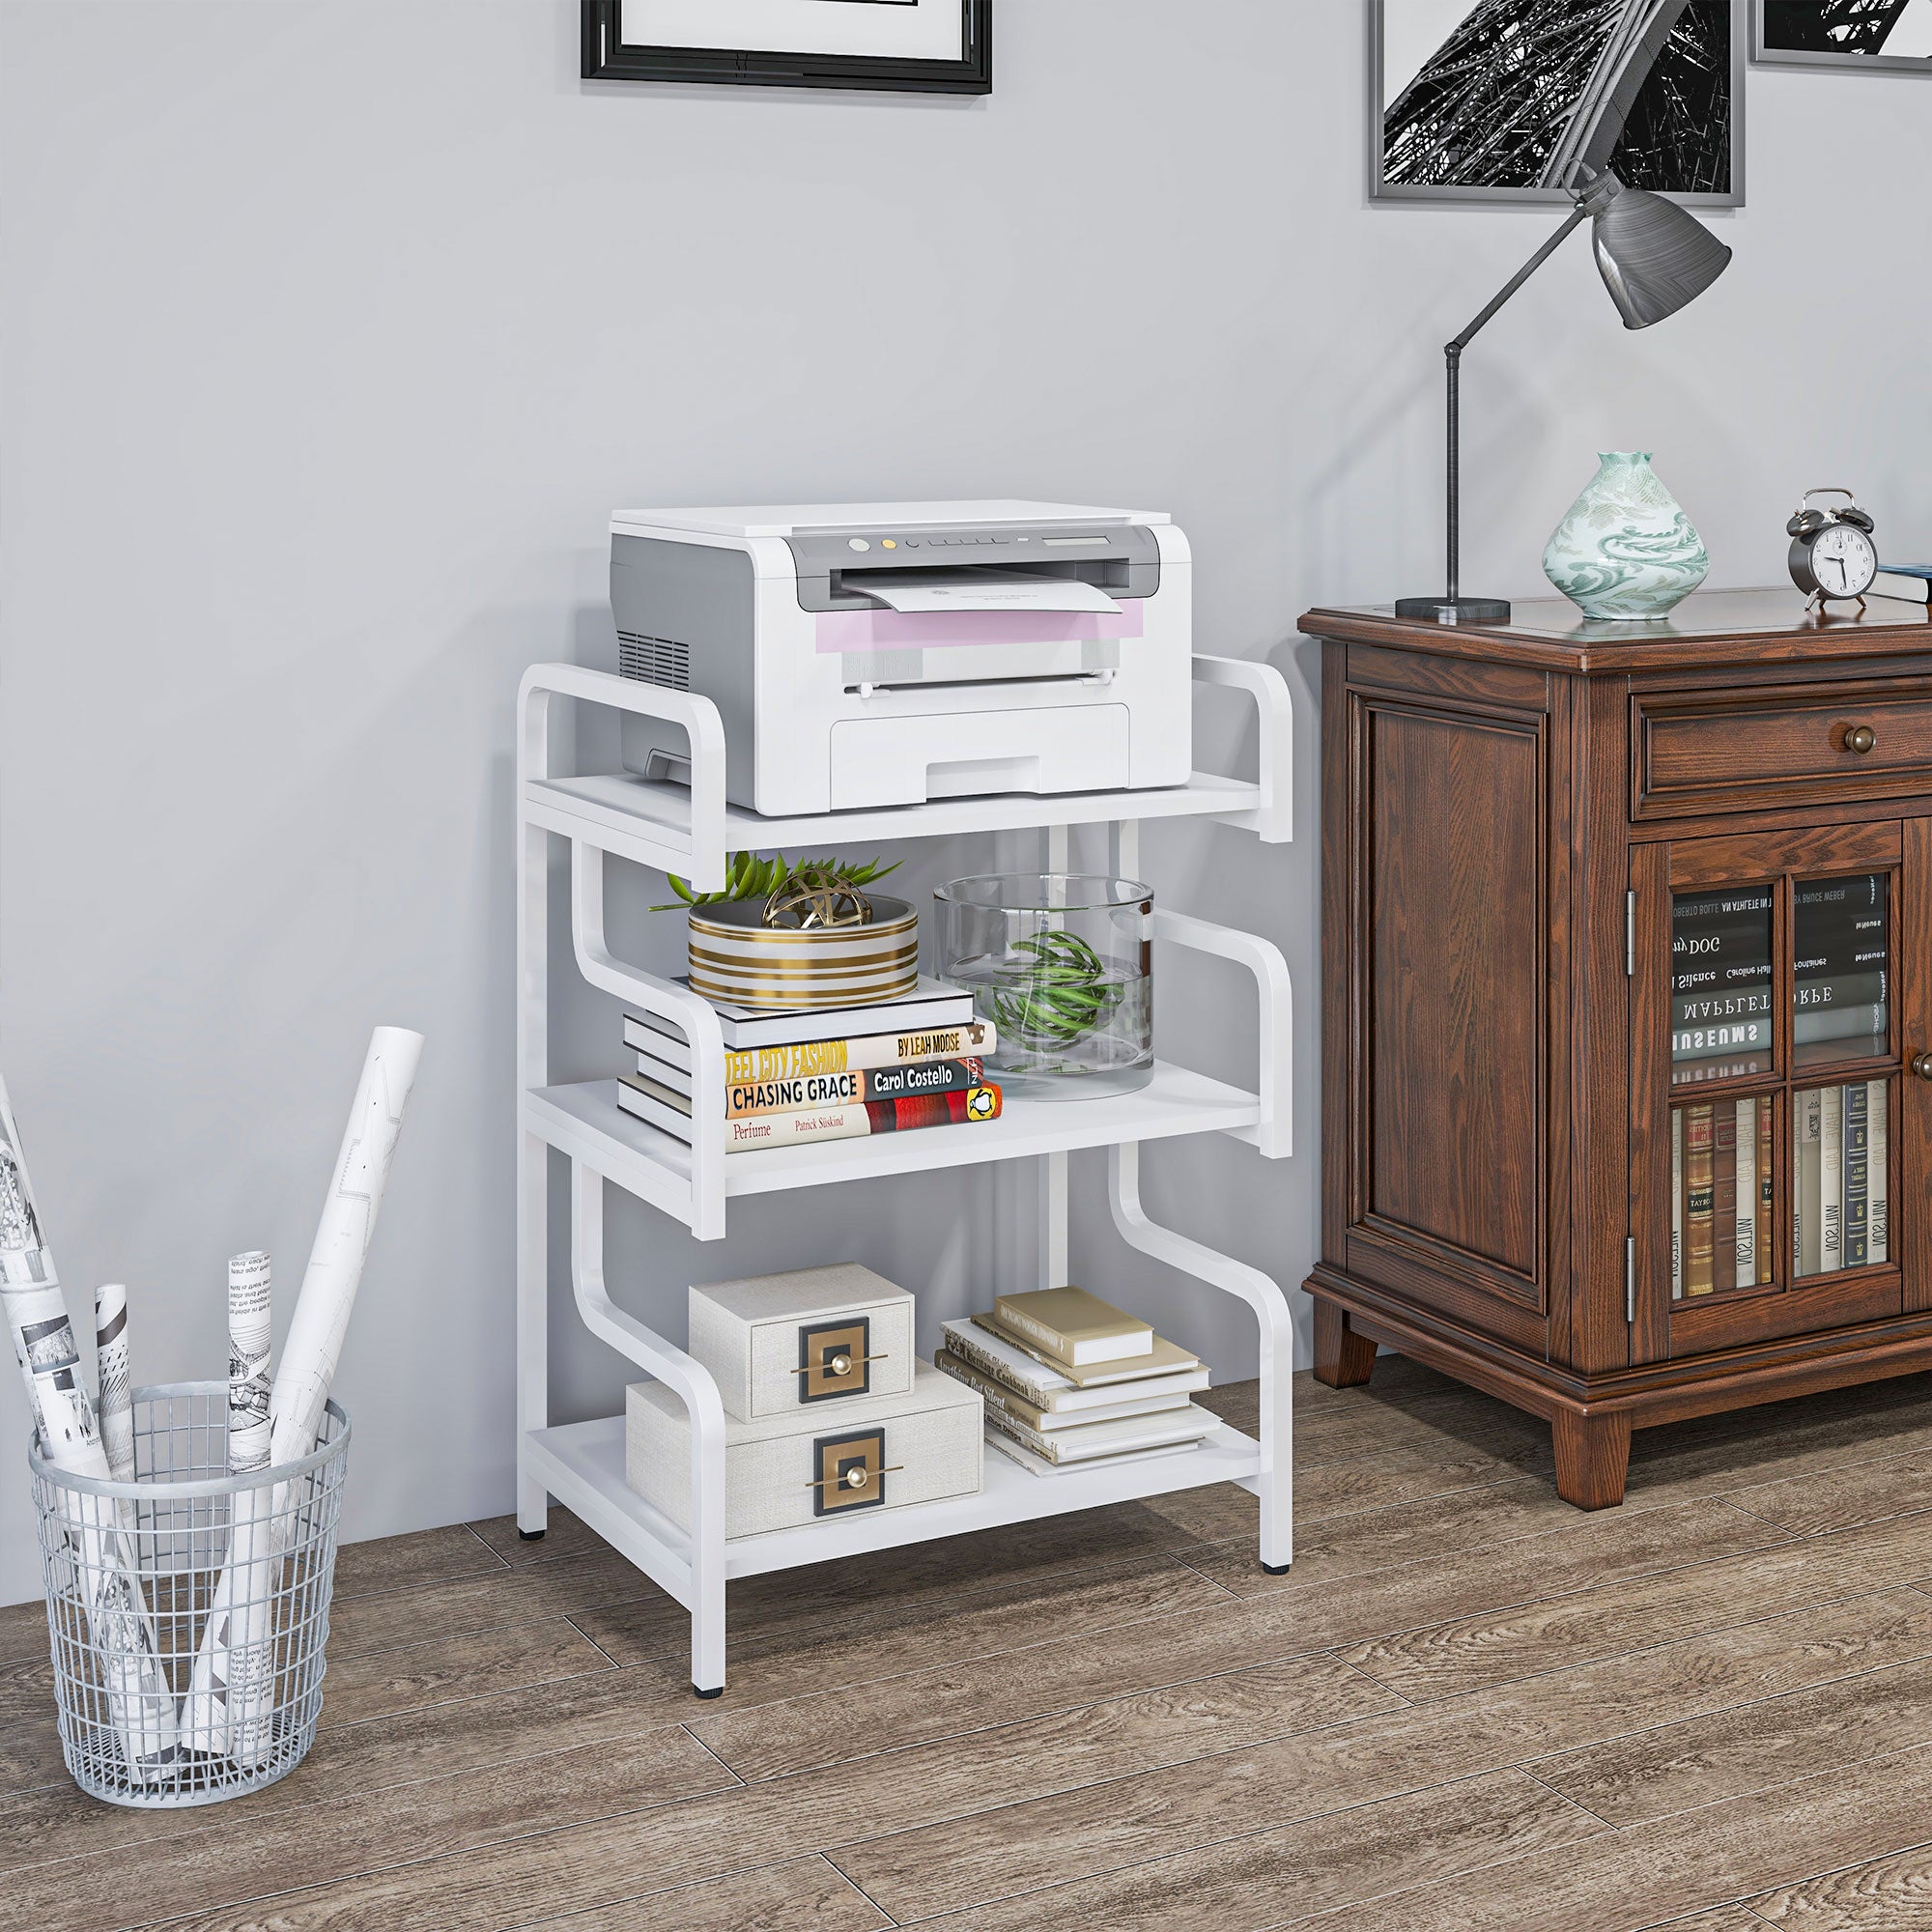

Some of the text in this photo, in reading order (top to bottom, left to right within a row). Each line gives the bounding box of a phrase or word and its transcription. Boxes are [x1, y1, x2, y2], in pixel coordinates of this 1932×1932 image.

[758, 1045, 788, 1081] CITY
[790, 1040, 848, 1078] FASHION
[898, 1037, 908, 1057] BY
[910, 1036, 931, 1055] LEAH
[933, 1033, 960, 1053] MOOSE
[733, 1065, 952, 1110] CHASING GRACE Carol Costello
[733, 1115, 844, 1140] Perfume Patrick Süskind
[940, 1358, 970, 1384] Anything
[971, 1377, 983, 1394] But
[984, 1385, 1005, 1410] Silent
[996, 1368, 1029, 1395] Cookbook
[1003, 1425, 1022, 1442] Drops
